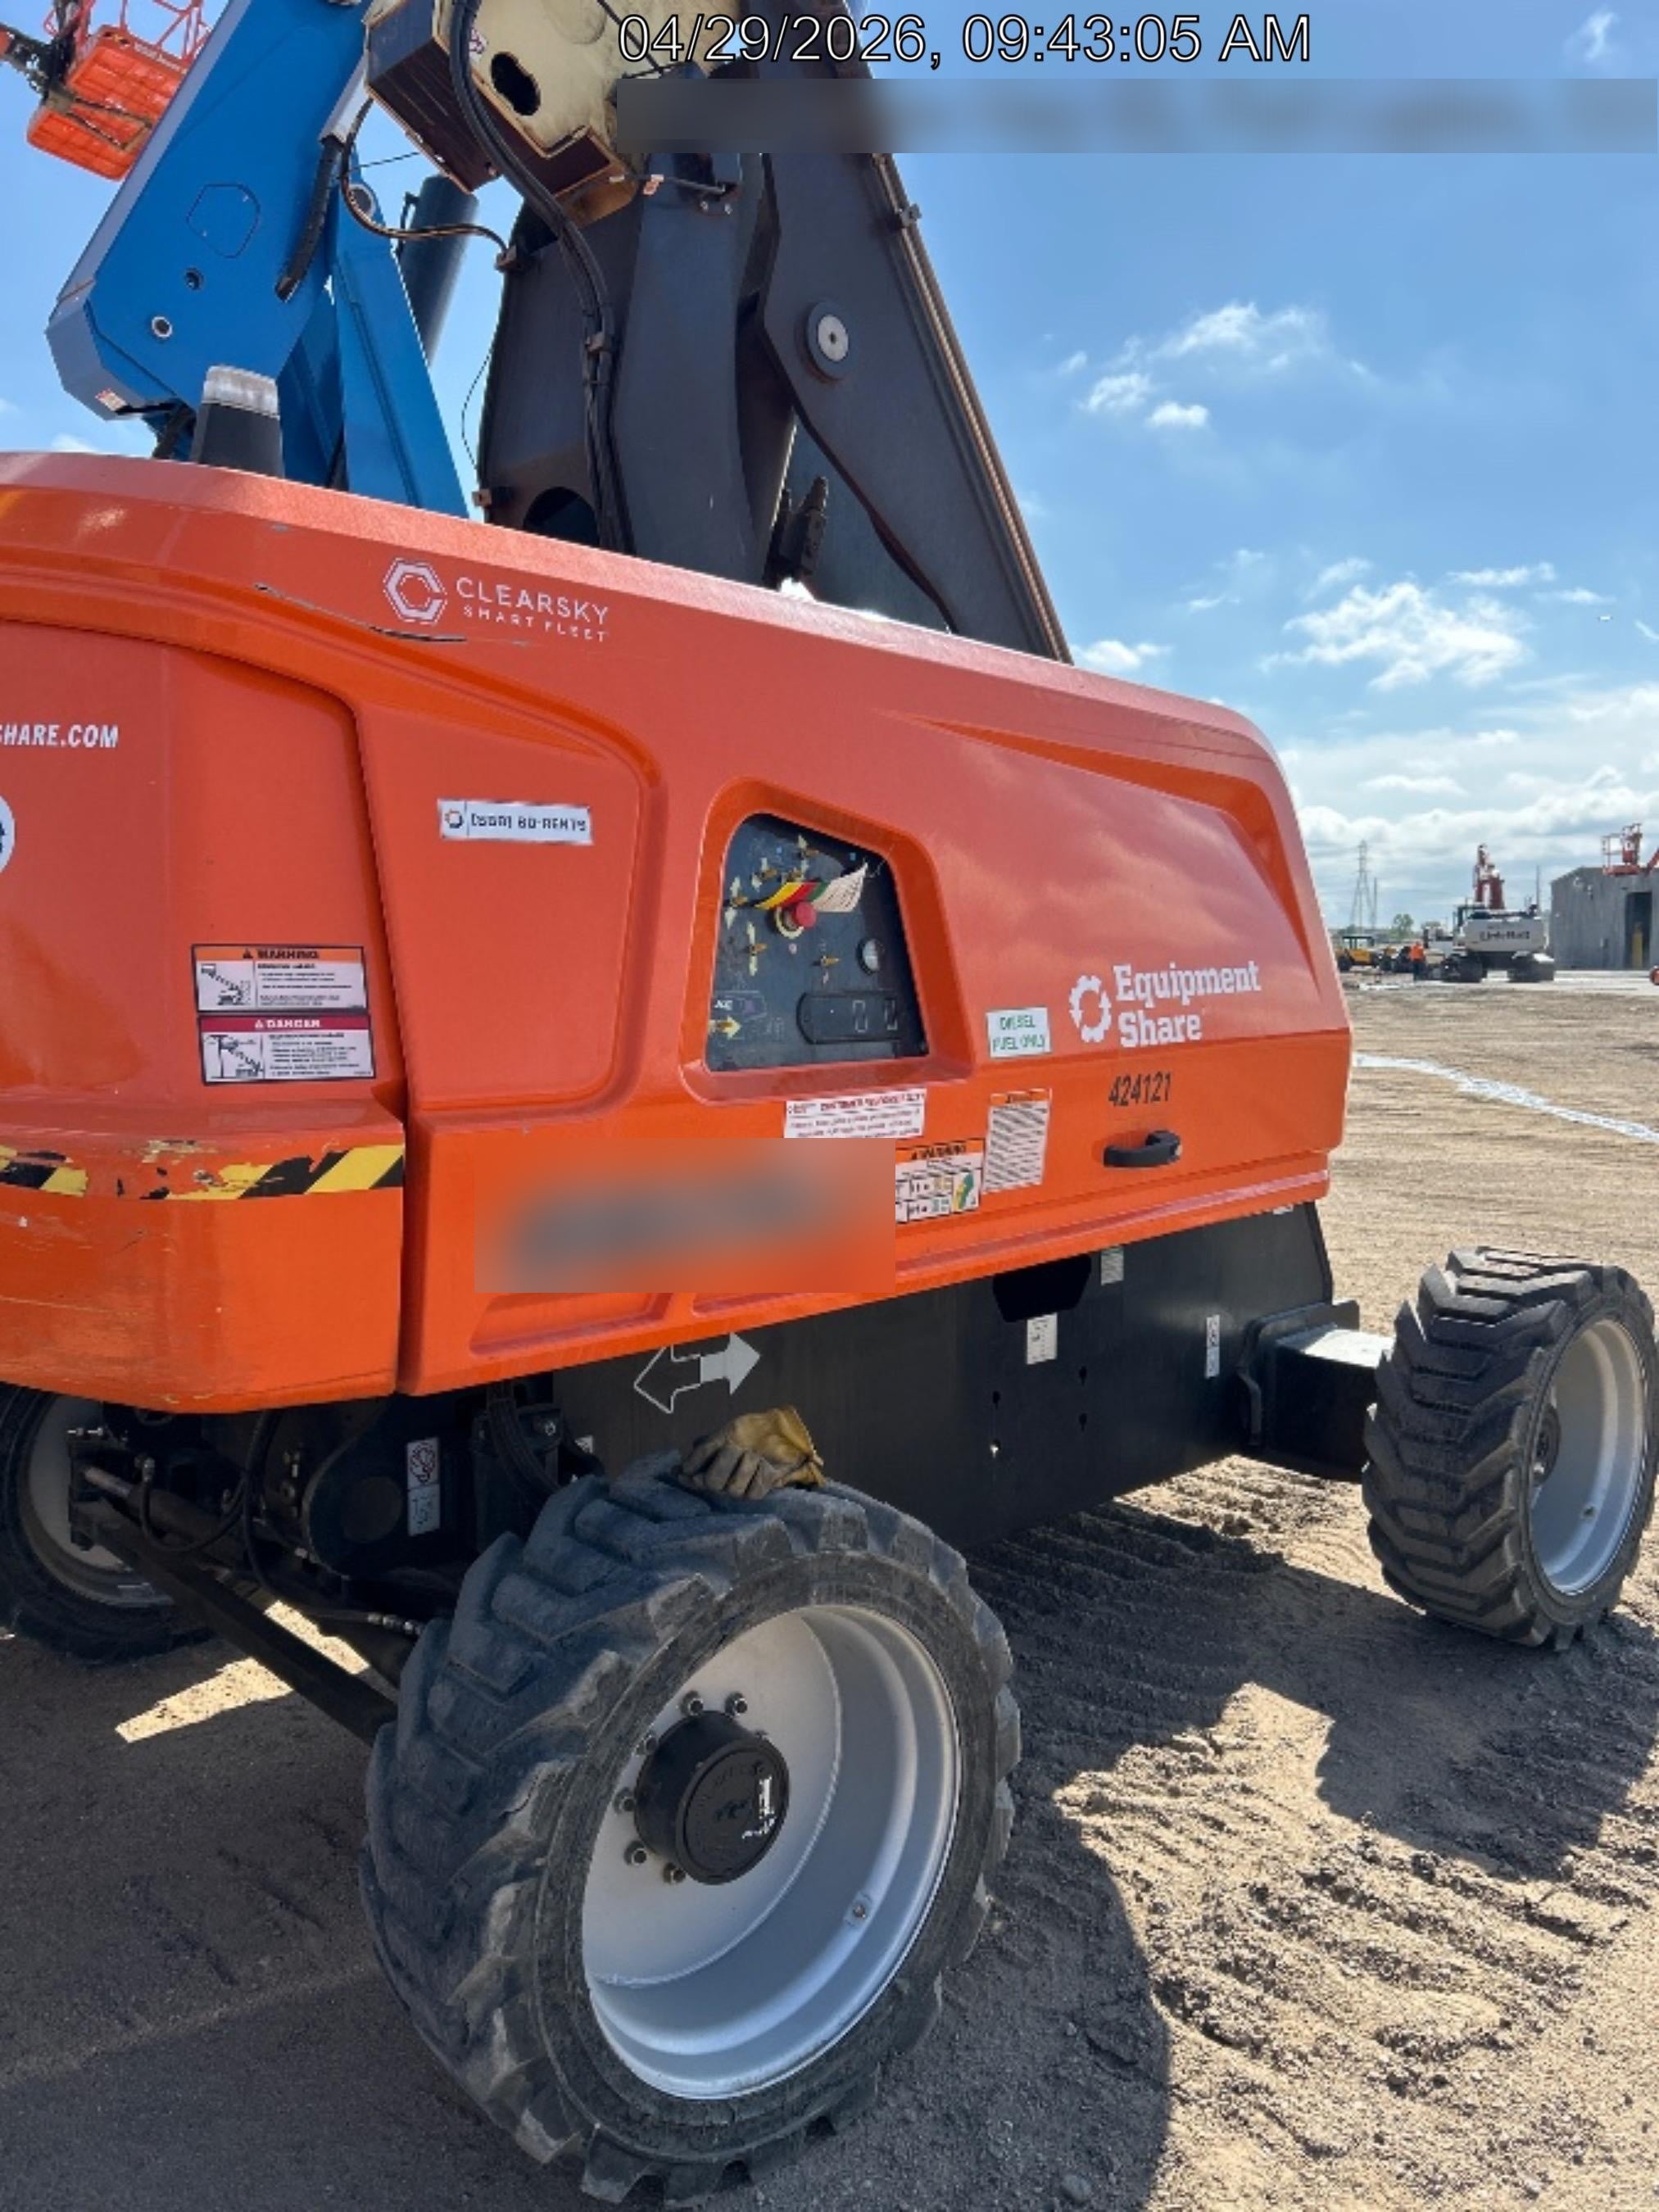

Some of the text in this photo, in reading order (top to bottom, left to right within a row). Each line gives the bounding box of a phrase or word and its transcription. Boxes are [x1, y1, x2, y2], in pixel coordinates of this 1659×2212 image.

[456, 577, 609, 625] CLEARSKY
[464, 605, 608, 642] SMART FLEET
[1113, 960, 1262, 1008] Equipment
[267, 1019, 321, 1029] DANGER
[1117, 1009, 1203, 1048] Share
[1108, 1071, 1172, 1107] 424121
